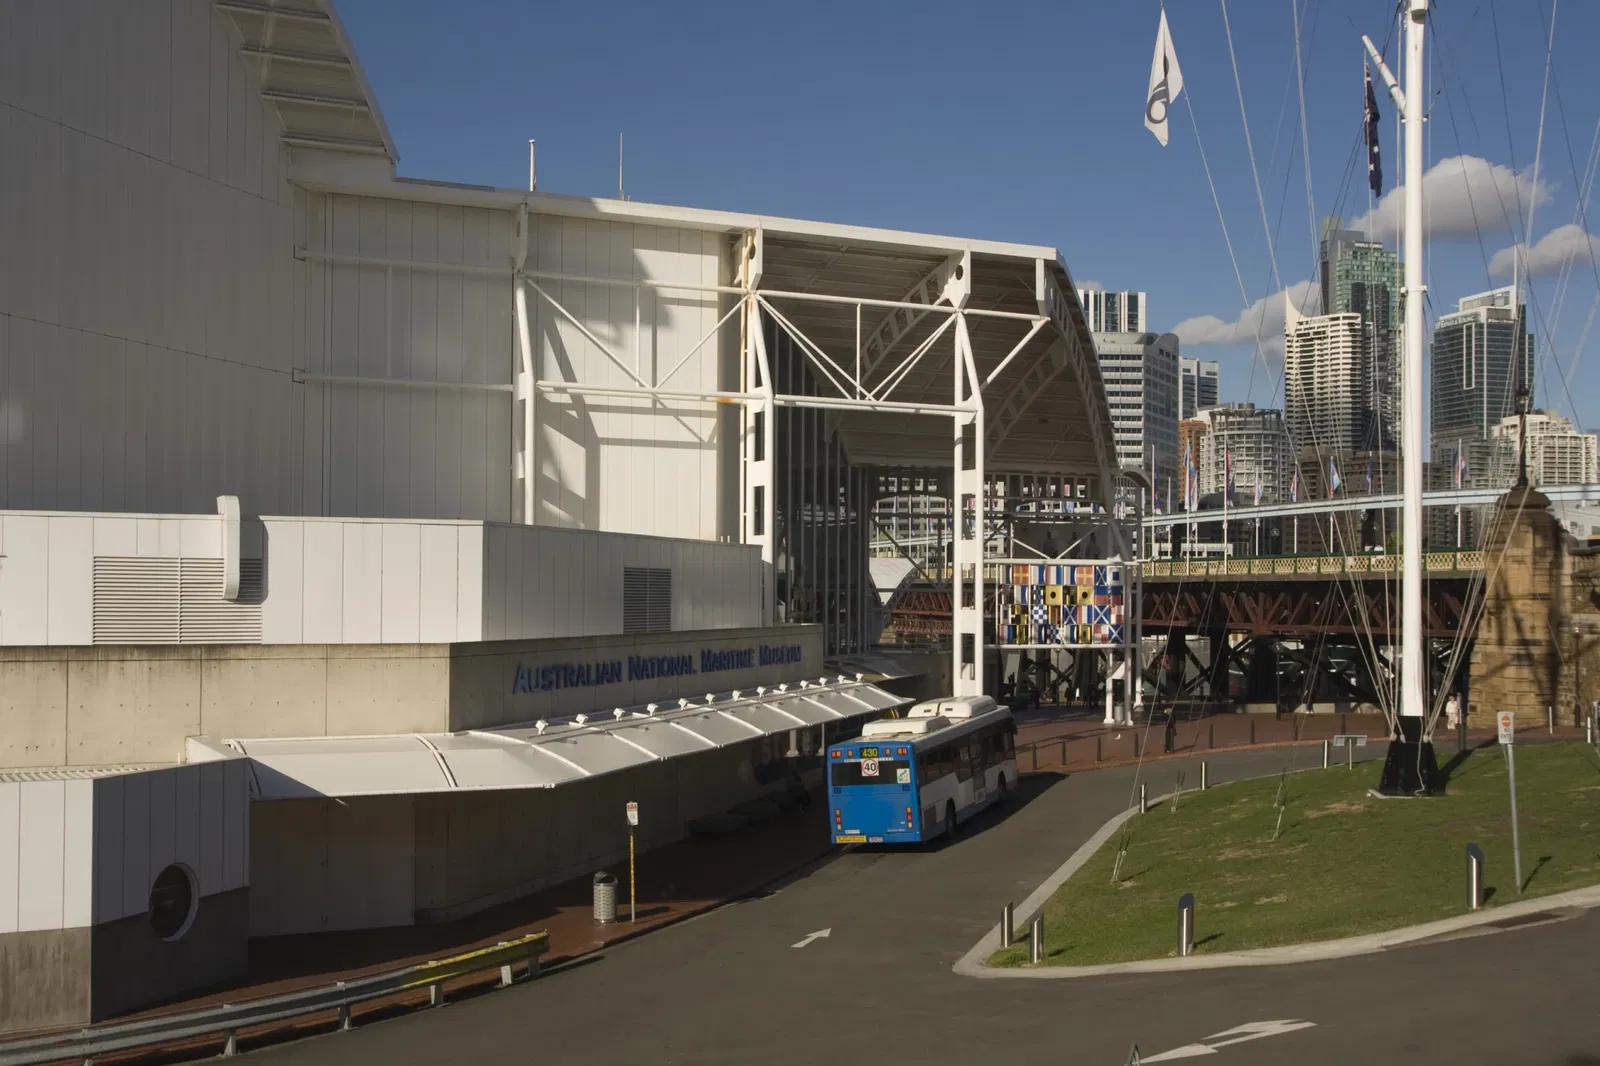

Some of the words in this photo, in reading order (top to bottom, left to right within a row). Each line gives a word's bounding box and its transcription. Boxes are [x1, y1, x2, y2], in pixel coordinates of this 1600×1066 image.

[512, 661, 622, 694] AUSTRALIAN
[628, 654, 697, 681] NATIONAL
[701, 648, 755, 673] MARITIME
[759, 644, 802, 666] MUSEUM
[863, 748, 877, 757] 430
[865, 763, 876, 772] 40
